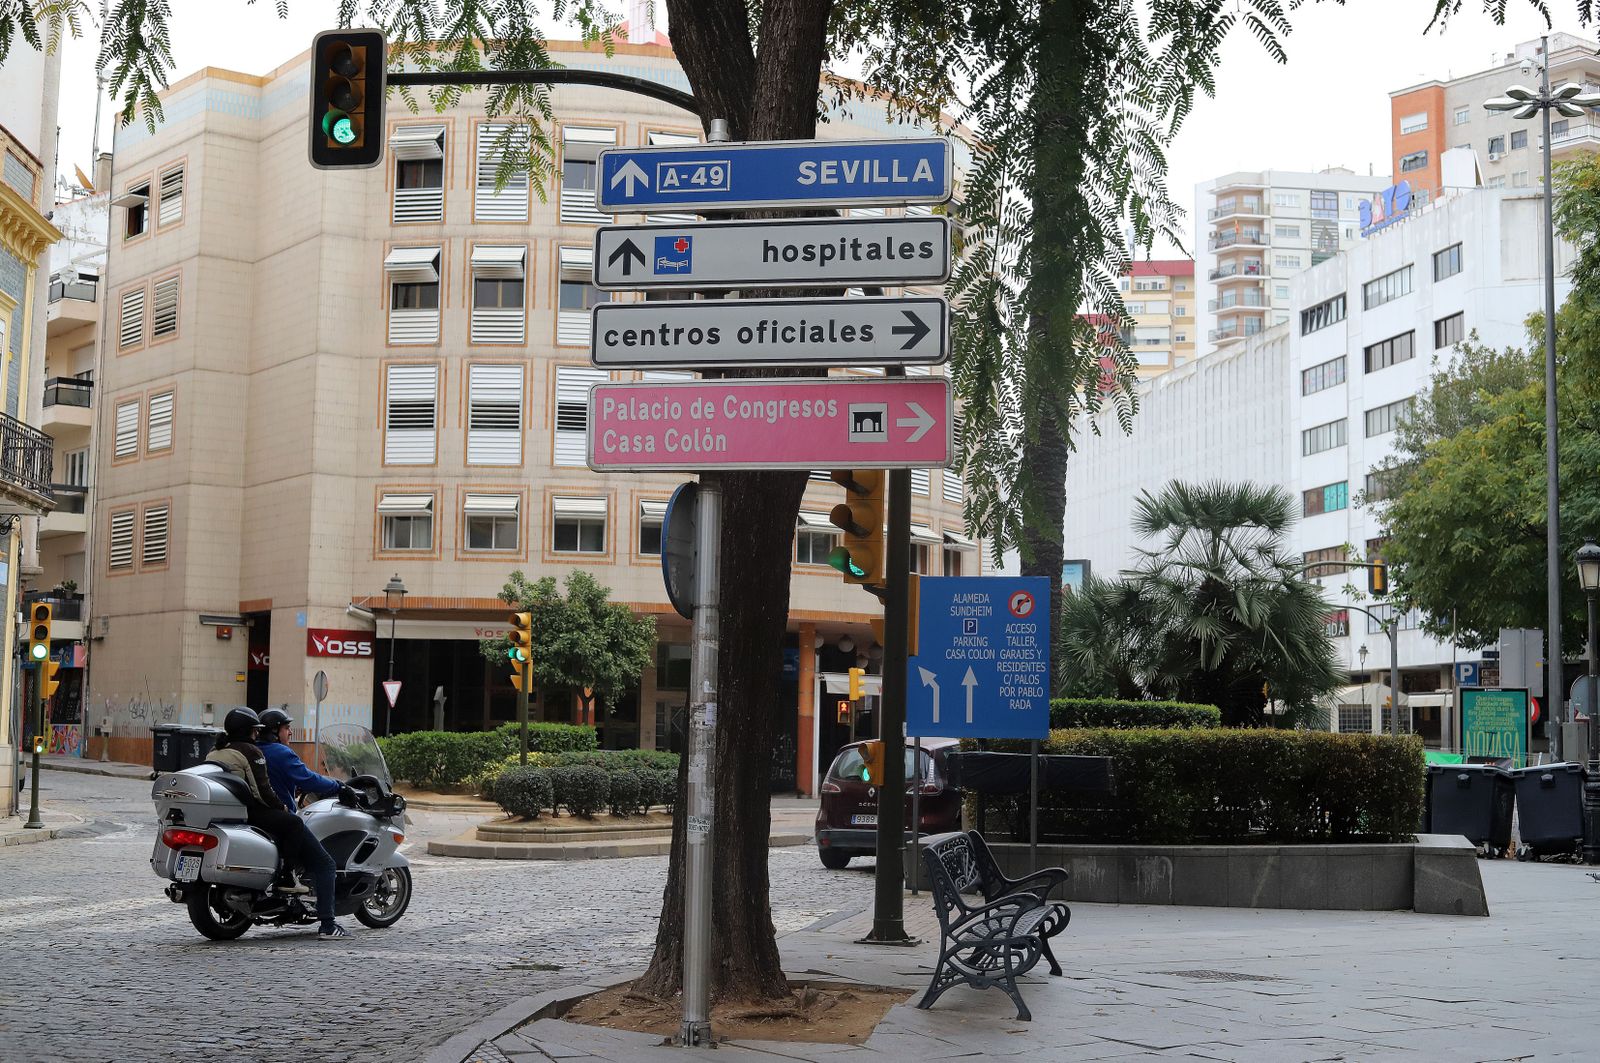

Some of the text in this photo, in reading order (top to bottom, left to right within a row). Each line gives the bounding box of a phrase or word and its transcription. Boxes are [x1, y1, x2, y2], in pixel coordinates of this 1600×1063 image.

[663, 158, 934, 187] A-49 SEVILLA
[762, 236, 934, 267] hospitales
[604, 319, 874, 347] centros oficiales
[603, 394, 838, 424] Palacio de Congresos
[603, 427, 727, 454] Casa Colón
[953, 593, 990, 604] ALAMEDA
[950, 606, 993, 617] SUNDHEIM
[967, 621, 974, 631] P
[1005, 623, 1037, 634] ACCESO
[312, 634, 372, 656] VOSS
[953, 636, 989, 647] PARKING
[1006, 636, 1038, 649] TALLER,
[945, 649, 996, 660] CASA COLON
[999, 649, 1042, 660] GARAJES Y
[996, 661, 1046, 672] RESIDENTES
[1460, 664, 1474, 682] P
[1003, 674, 1040, 685] C/ PALOS
[999, 687, 1044, 697] POR PABLO
[1009, 699, 1032, 710] RADA
